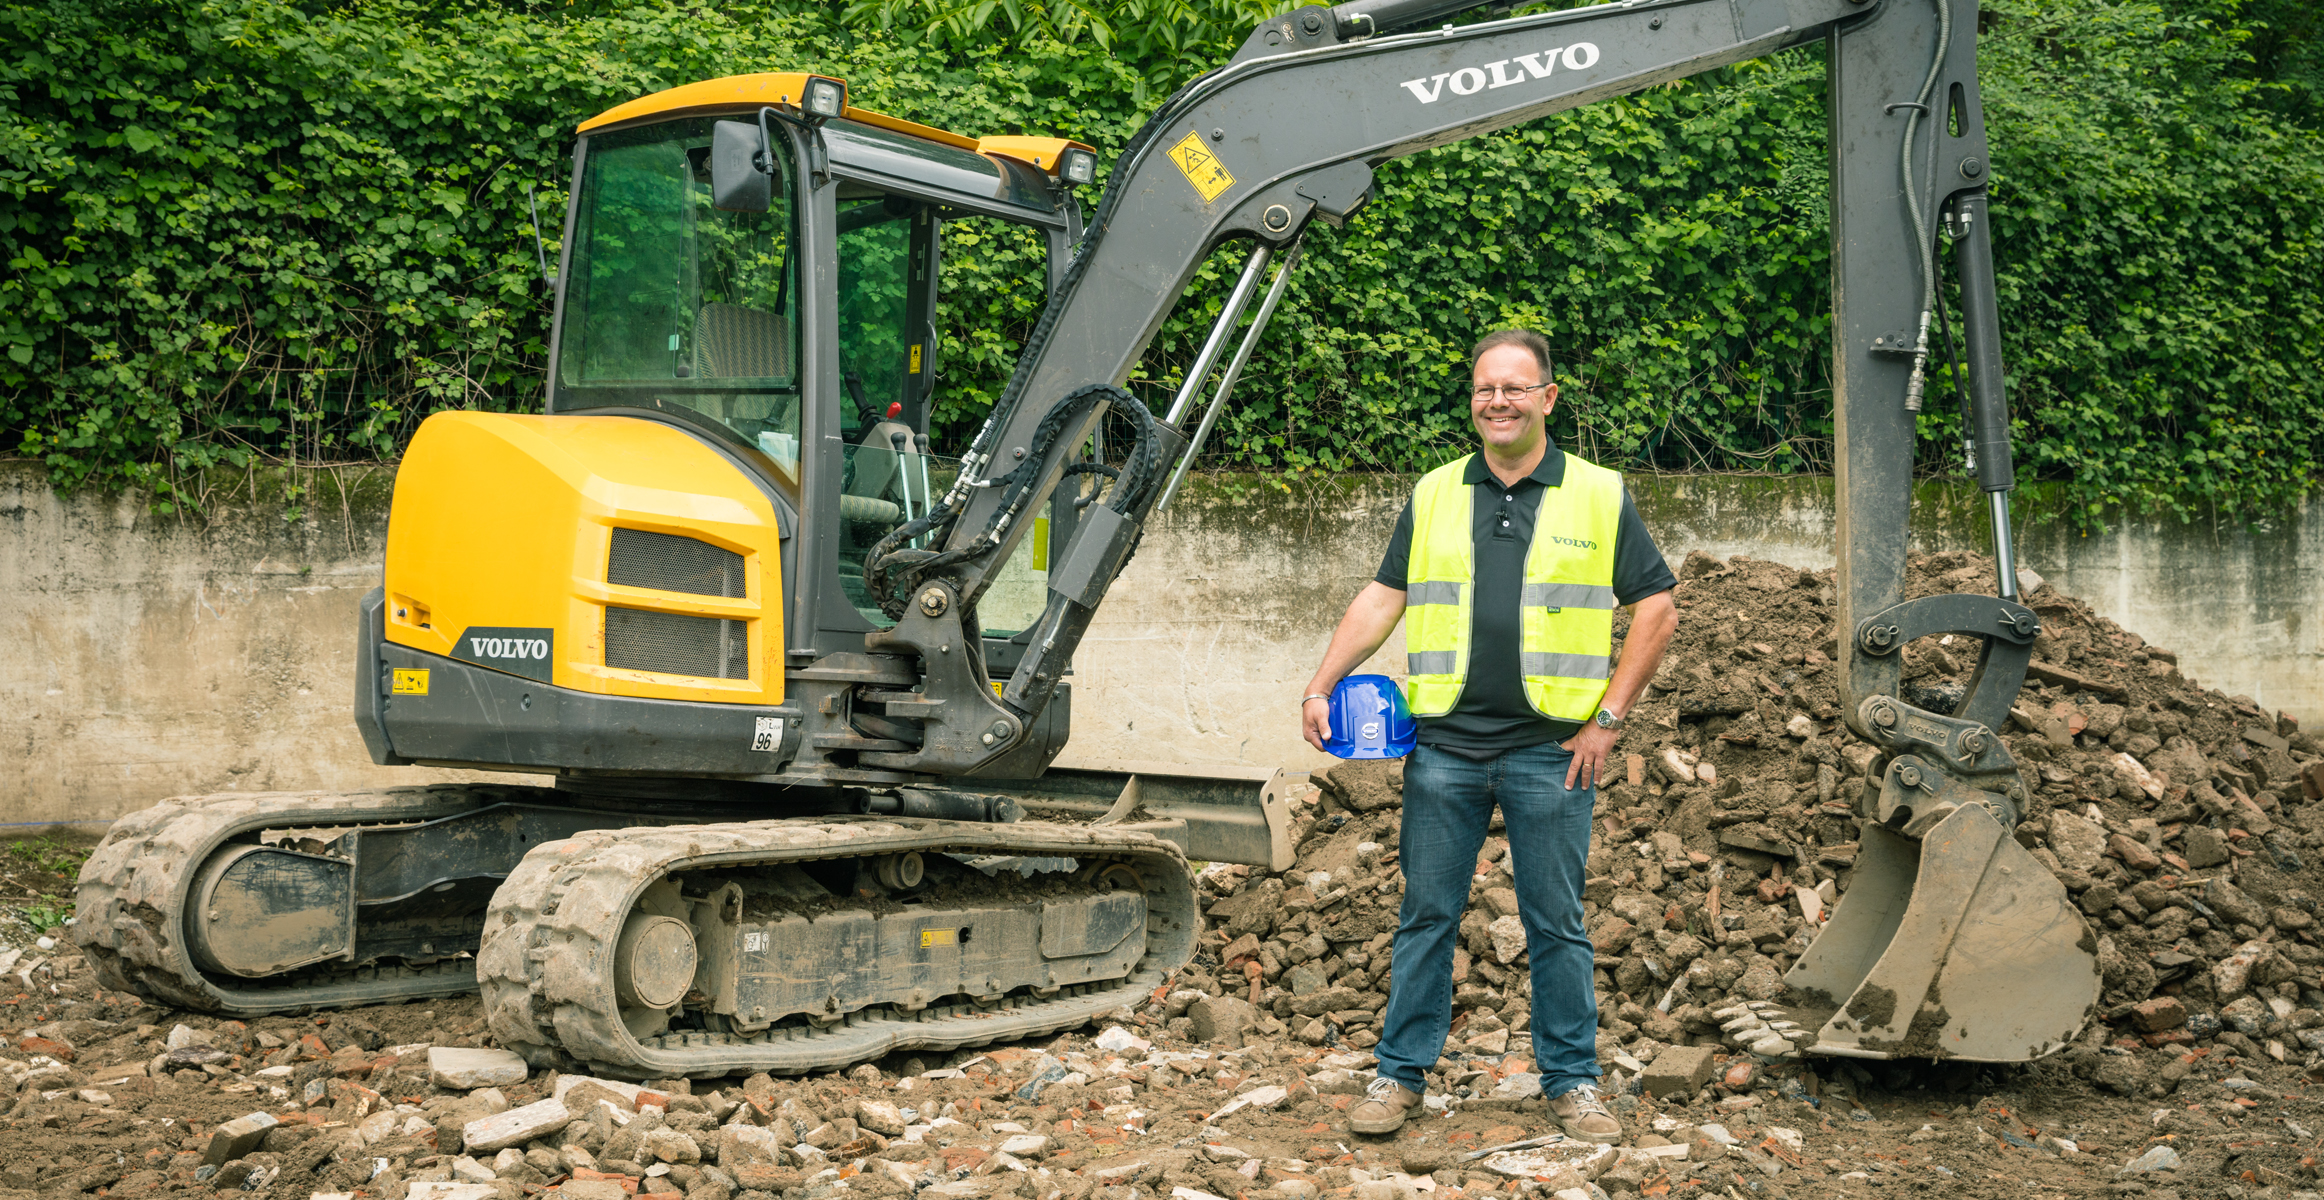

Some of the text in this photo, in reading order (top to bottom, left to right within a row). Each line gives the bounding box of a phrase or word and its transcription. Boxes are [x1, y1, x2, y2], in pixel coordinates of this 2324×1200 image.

[1400, 42, 1600, 104] VOLVO
[1551, 535, 1598, 551] VOLVO
[470, 637, 548, 660] VOLVO
[1907, 722, 1947, 739] VOLVO
[756, 732, 772, 750] 96
